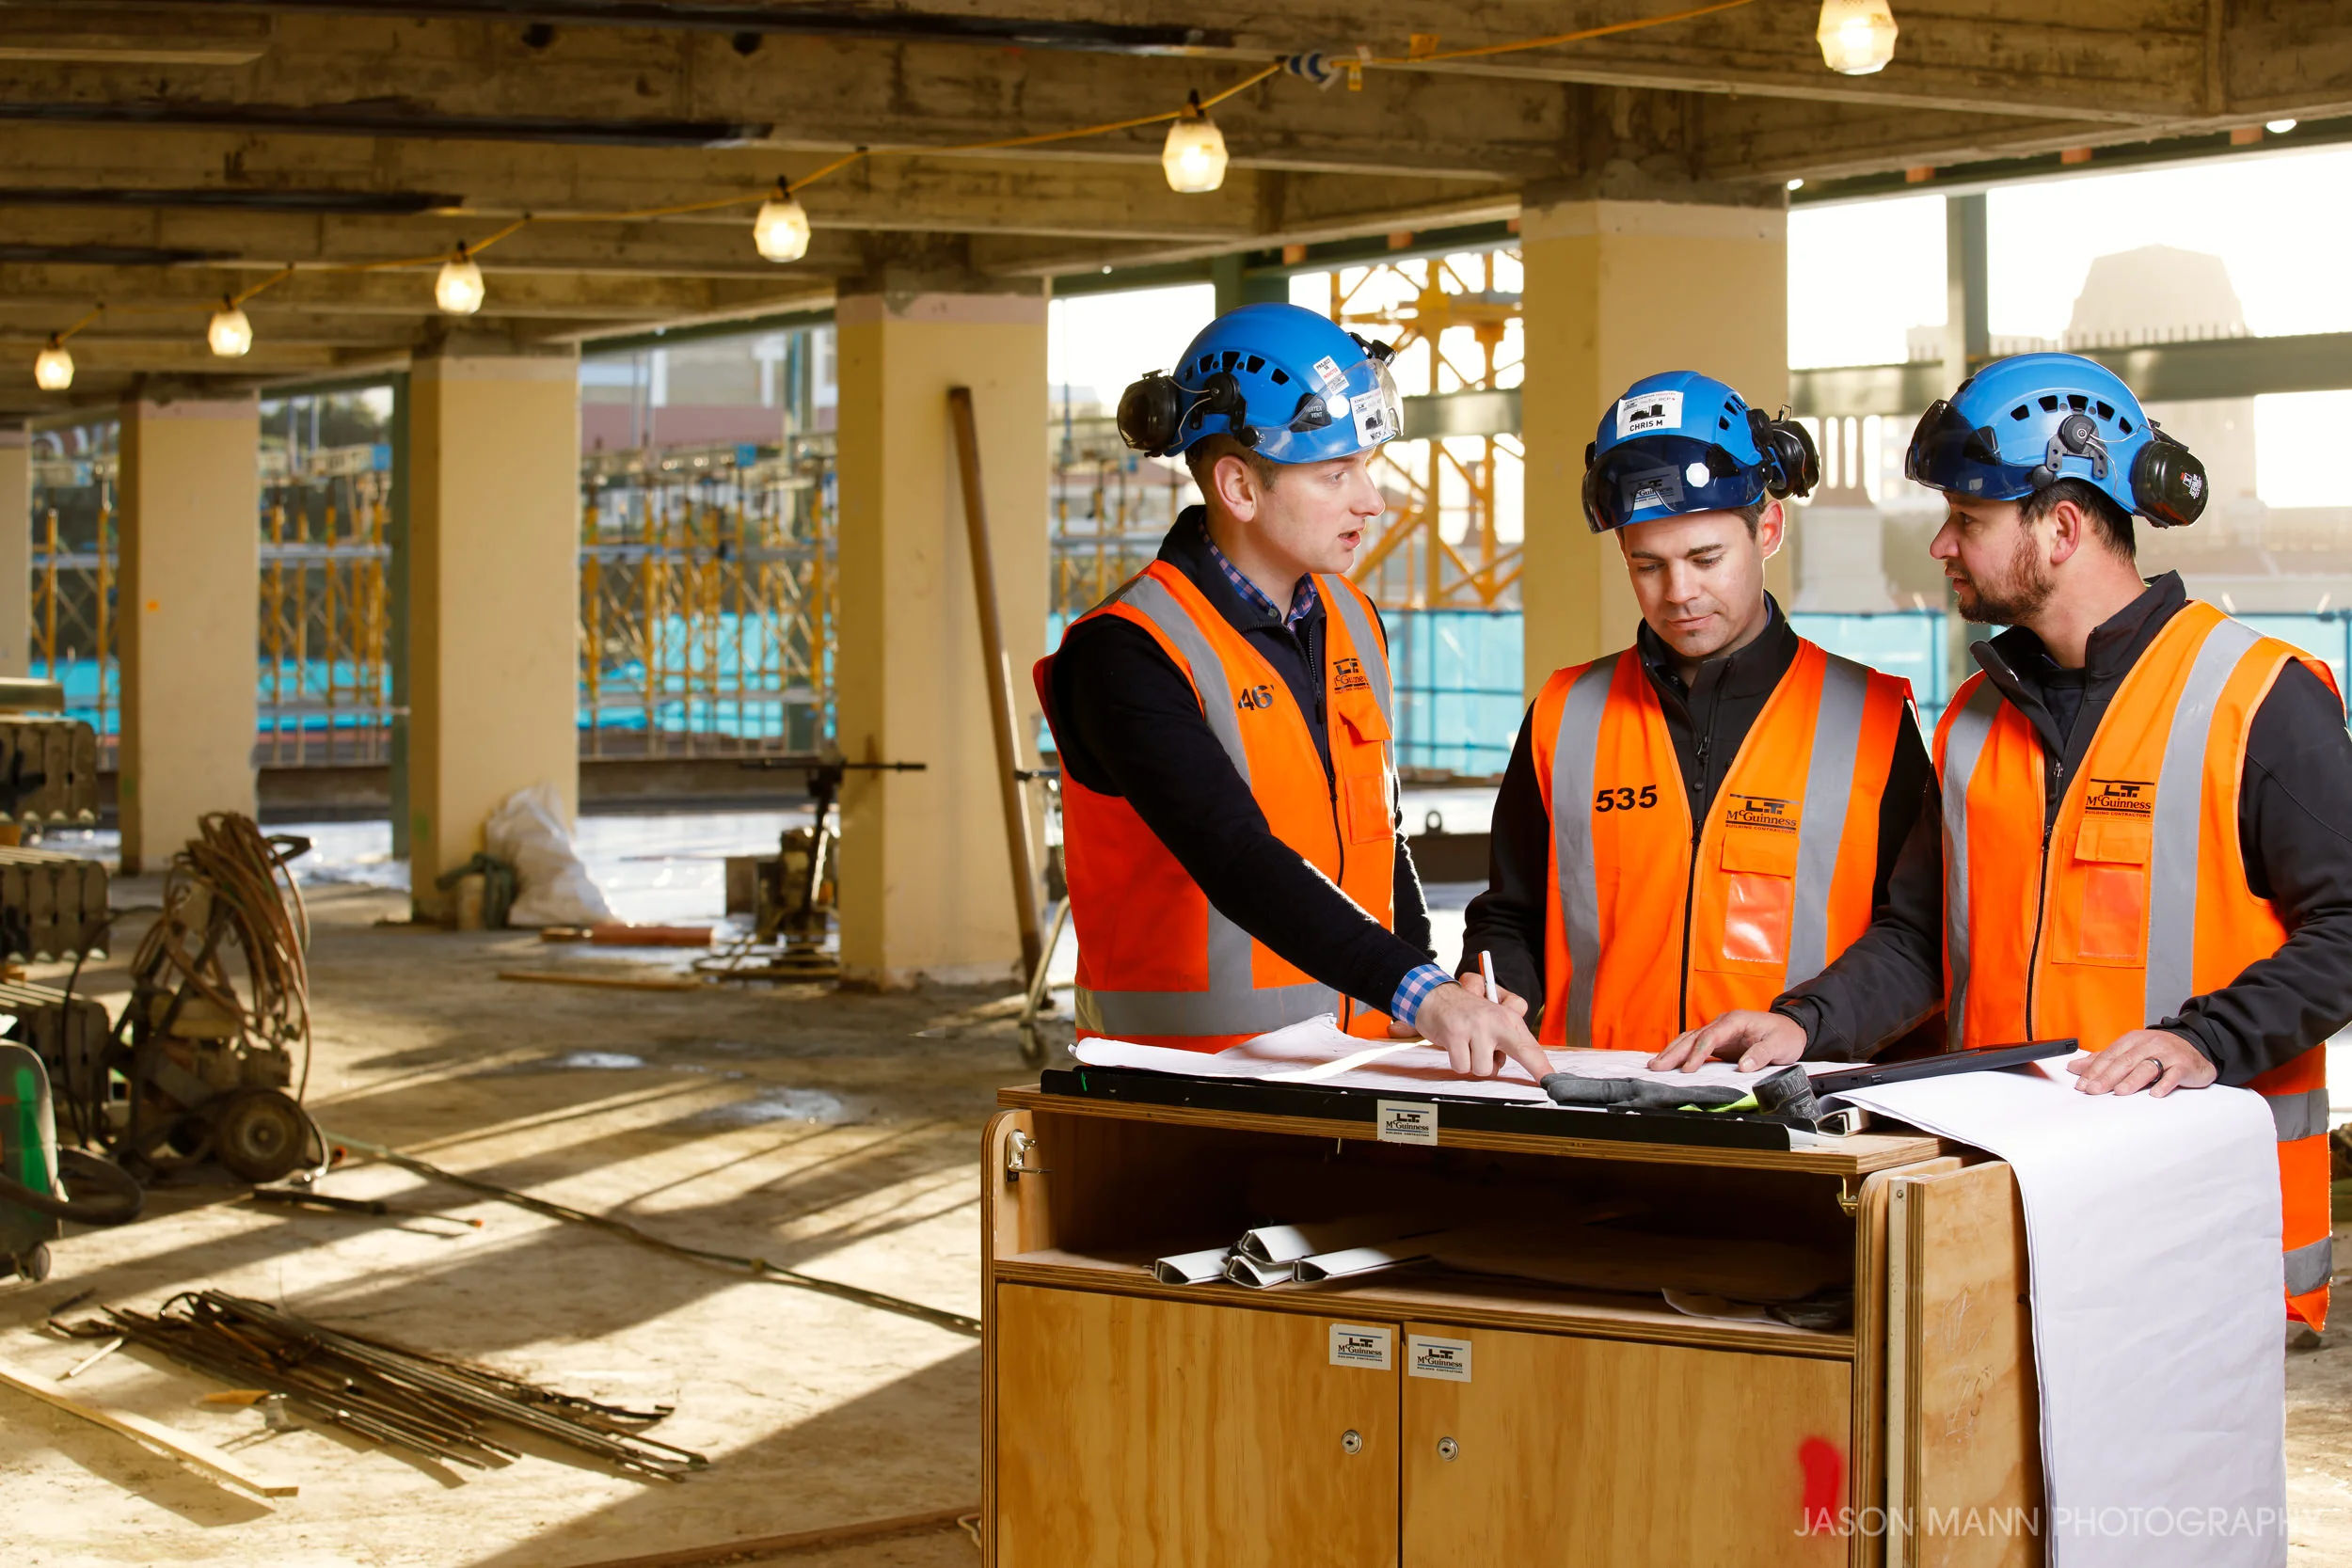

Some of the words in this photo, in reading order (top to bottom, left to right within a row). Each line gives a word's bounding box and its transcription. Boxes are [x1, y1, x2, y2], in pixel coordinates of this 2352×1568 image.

[1629, 420, 1654, 432] CHRIS
[1238, 685, 1275, 710] 46
[1596, 784, 1658, 812] 535
[2086, 795, 2152, 810] McGuinness
[1726, 809, 1797, 826] McGuinness
[1754, 826, 1795, 834] CONTRACTORS
[1386, 1119, 1429, 1131] McGuinness
[1338, 1344, 1383, 1356] McGuinness
[1417, 1355, 1463, 1368] McGuinness
